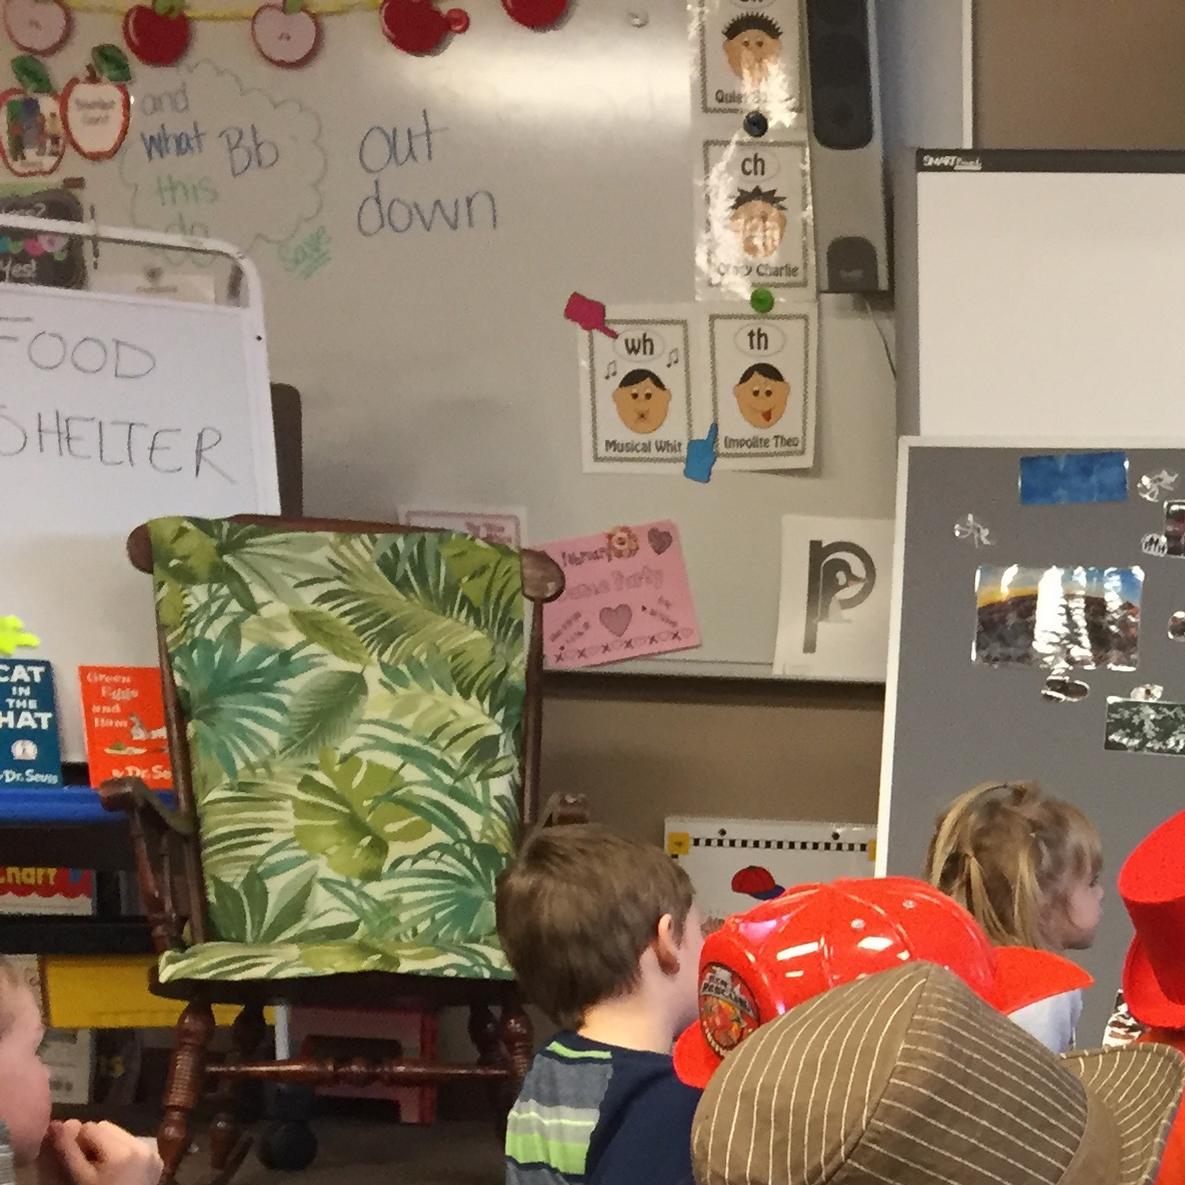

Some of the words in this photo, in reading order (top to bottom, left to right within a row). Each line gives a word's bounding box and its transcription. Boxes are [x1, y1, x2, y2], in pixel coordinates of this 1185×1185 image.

[140, 81, 189, 116] and
[218, 123, 280, 179] Bb
[358, 109, 449, 173] out
[741, 152, 766, 176] ch
[357, 179, 498, 238] down
[624, 332, 655, 356] wh
[747, 327, 769, 350] th
[604, 439, 652, 454] Musical
[0, 664, 46, 683] CAT
[11, 686, 31, 697] IN
[5, 698, 38, 710] THE
[0, 711, 53, 730] HAT
[25, 769, 59, 784] Seuss
